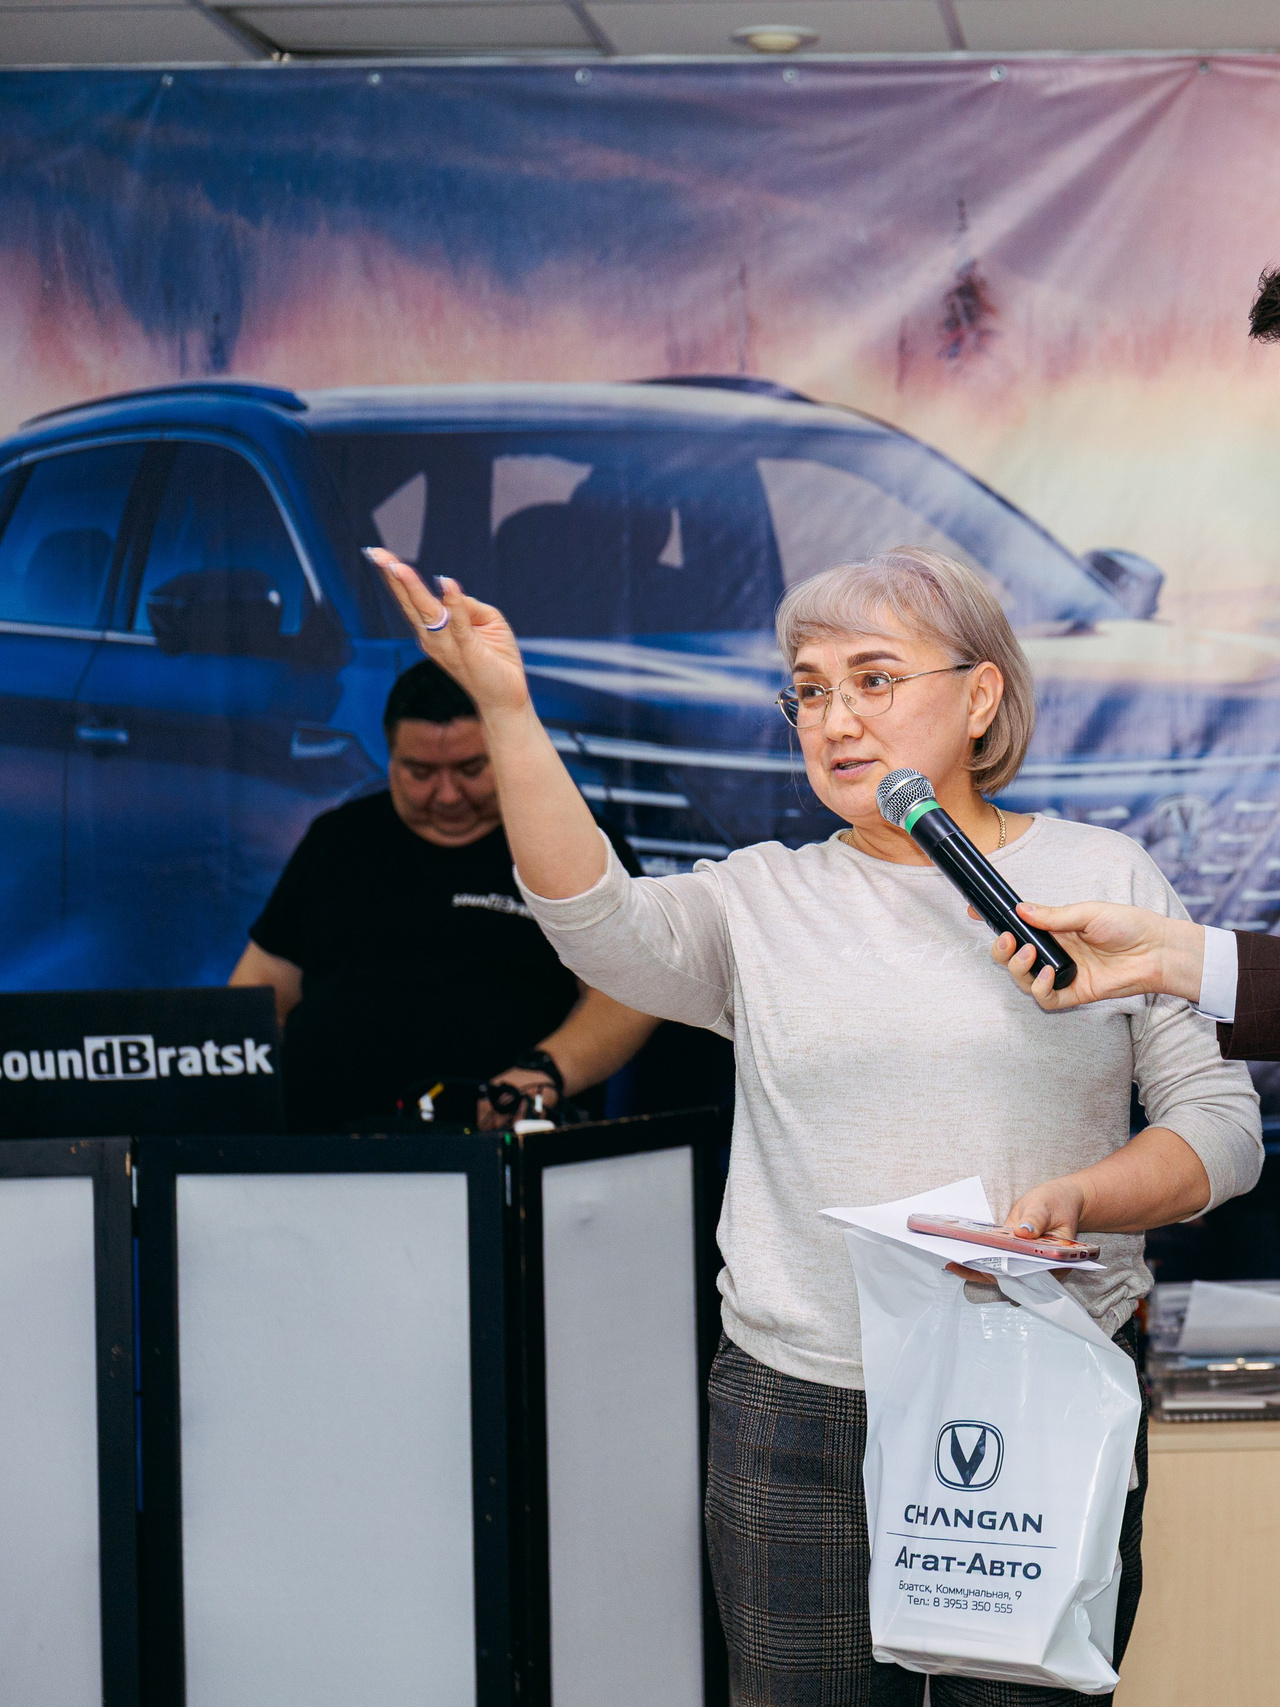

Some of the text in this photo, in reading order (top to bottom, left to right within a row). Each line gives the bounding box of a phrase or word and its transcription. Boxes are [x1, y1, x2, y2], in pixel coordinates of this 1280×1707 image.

[0, 1035, 274, 1081] oundBratsk
[904, 1504, 1043, 1533] CHANGAN
[894, 1546, 1042, 1580] Агат-Авто
[907, 1594, 1013, 1614] Тел.: 8 3953 350 555
[936, 1584, 1011, 1601] Коммунальная,
[1015, 1590, 1022, 1601] 9
